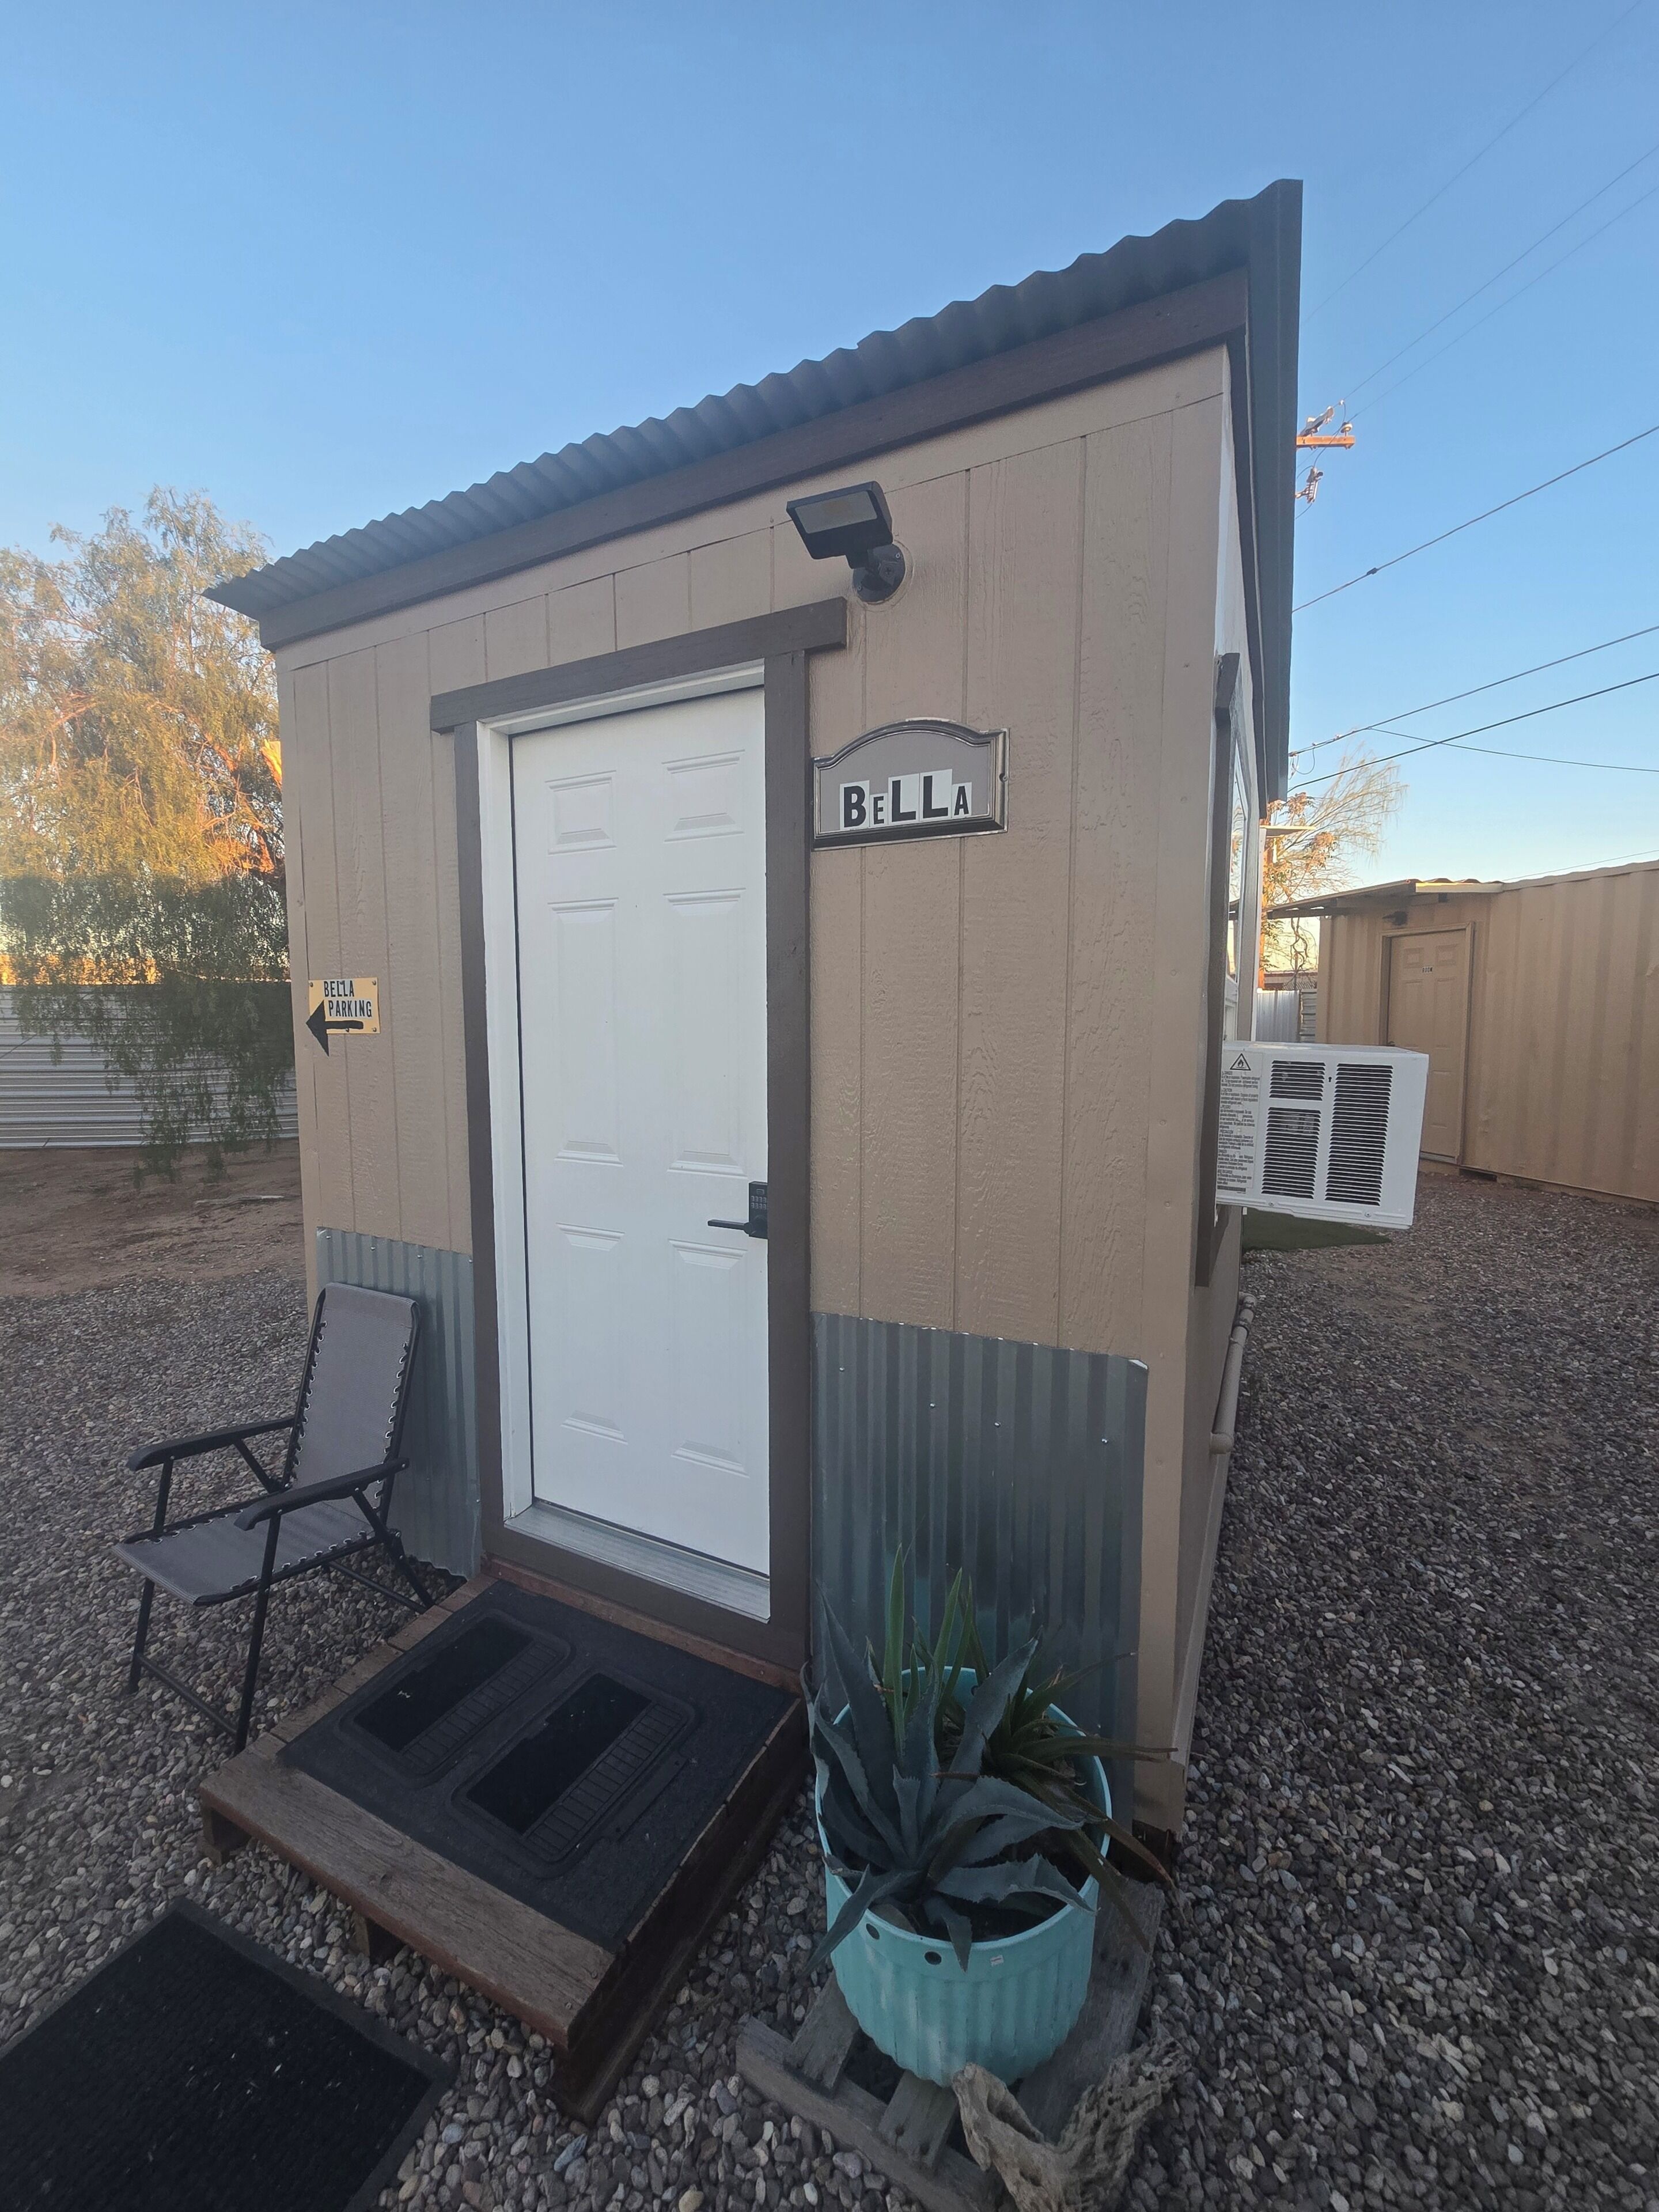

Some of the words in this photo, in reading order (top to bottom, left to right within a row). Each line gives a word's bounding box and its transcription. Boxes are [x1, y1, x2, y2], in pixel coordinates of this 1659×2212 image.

[843, 775, 969, 828] BELLA
[324, 980, 354, 997] BELLA
[328, 1000, 372, 1017] PARKING
